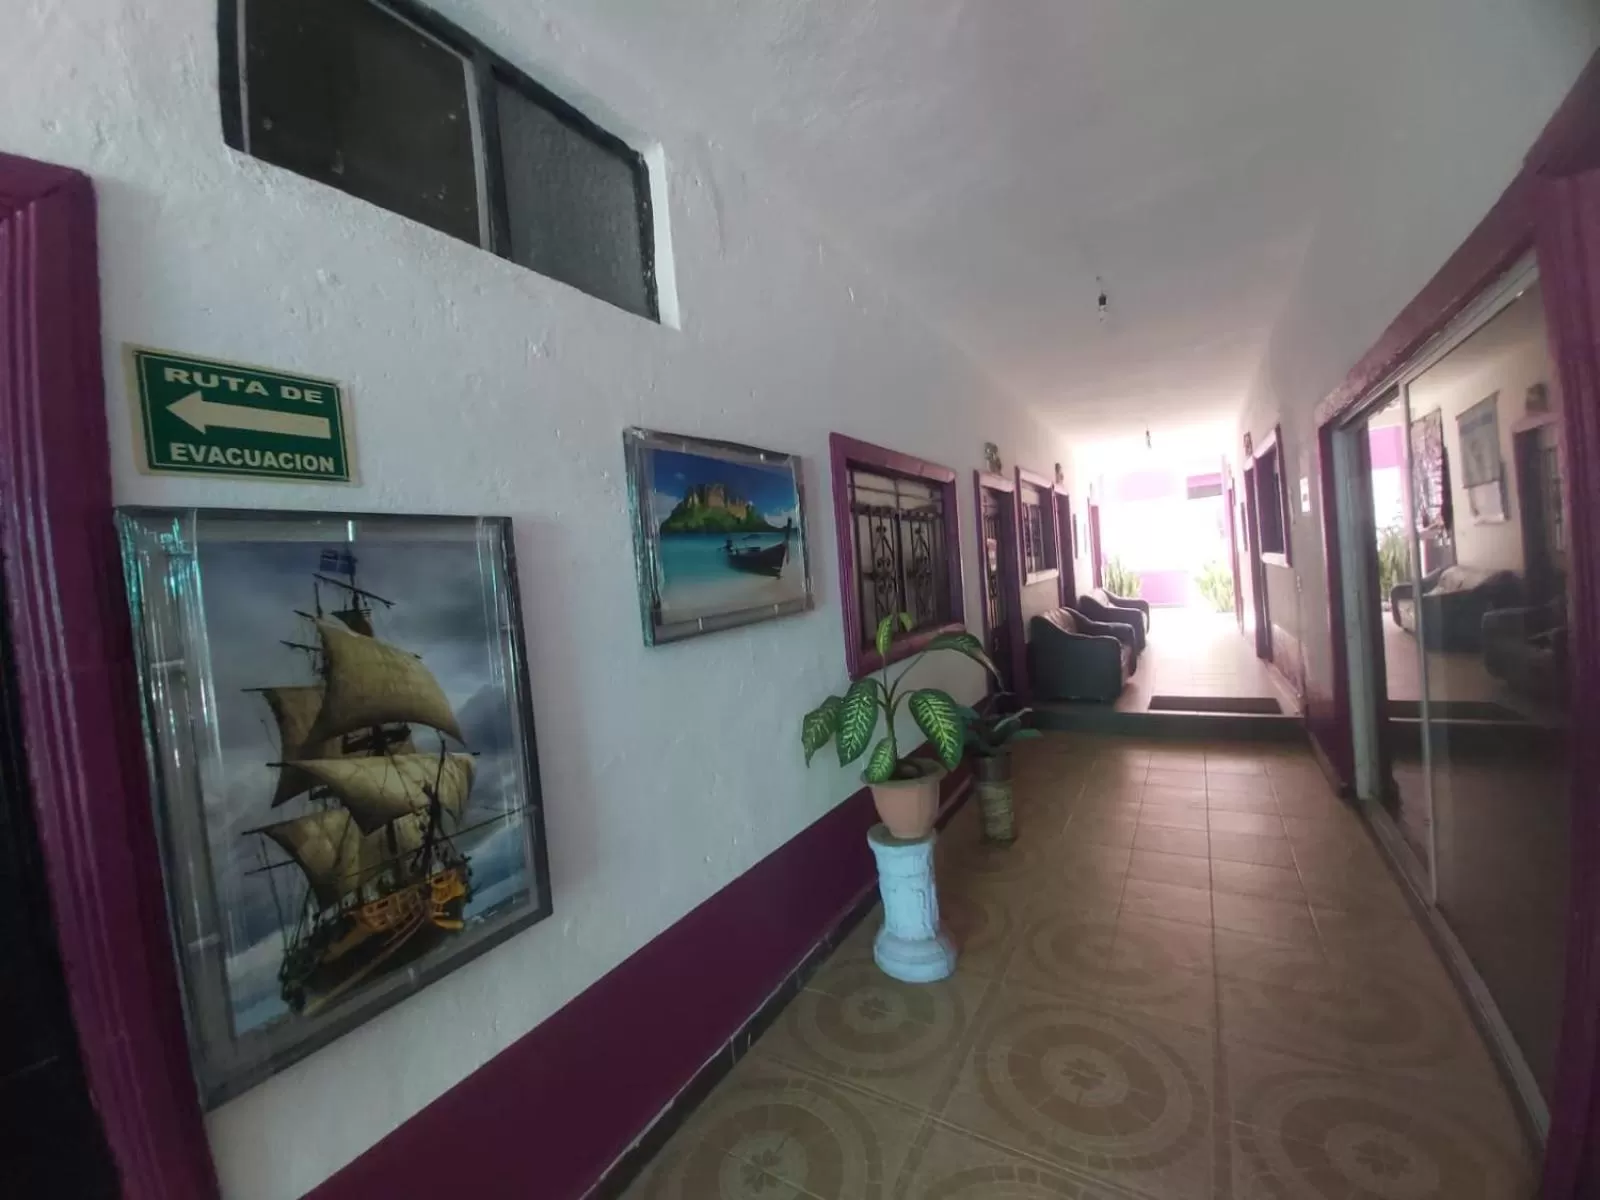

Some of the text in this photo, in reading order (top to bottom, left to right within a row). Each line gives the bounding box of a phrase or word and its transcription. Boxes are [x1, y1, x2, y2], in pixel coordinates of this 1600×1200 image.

[164, 367, 324, 404] RUTA DE
[169, 442, 335, 473] EVACUACION
